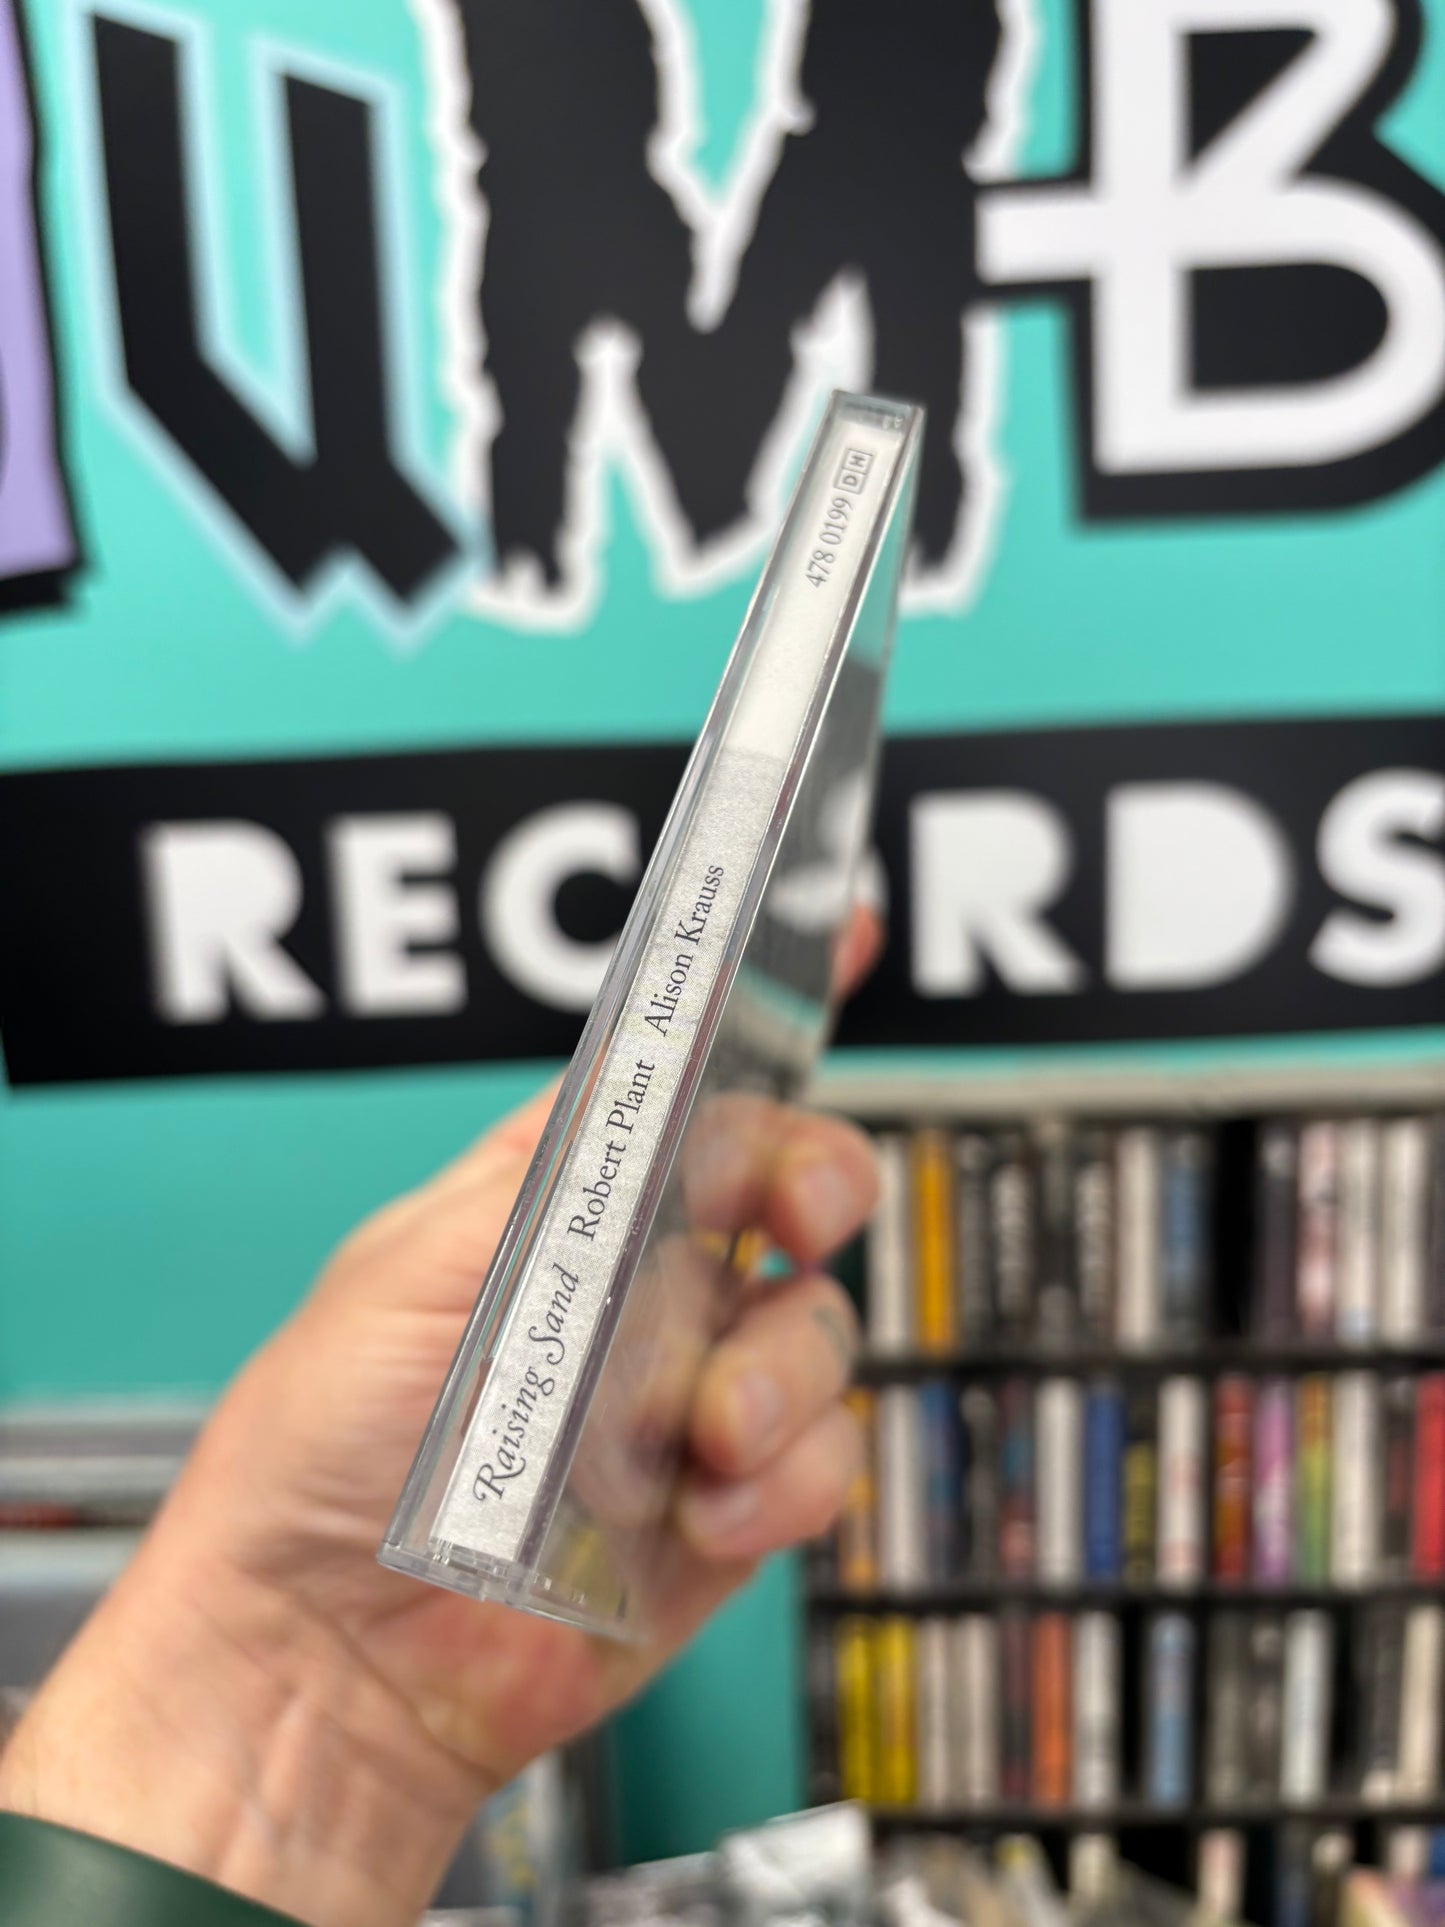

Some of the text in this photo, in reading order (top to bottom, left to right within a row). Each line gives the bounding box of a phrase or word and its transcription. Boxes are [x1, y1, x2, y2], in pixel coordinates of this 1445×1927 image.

[0, 0, 1445, 630] UMB
[806, 549, 835, 588] 478
[819, 497, 854, 545] 0199
[143, 766, 1445, 1024] RECRDS
[473, 864, 725, 1502] Raising Sand Robert Plant Alison Krauss
